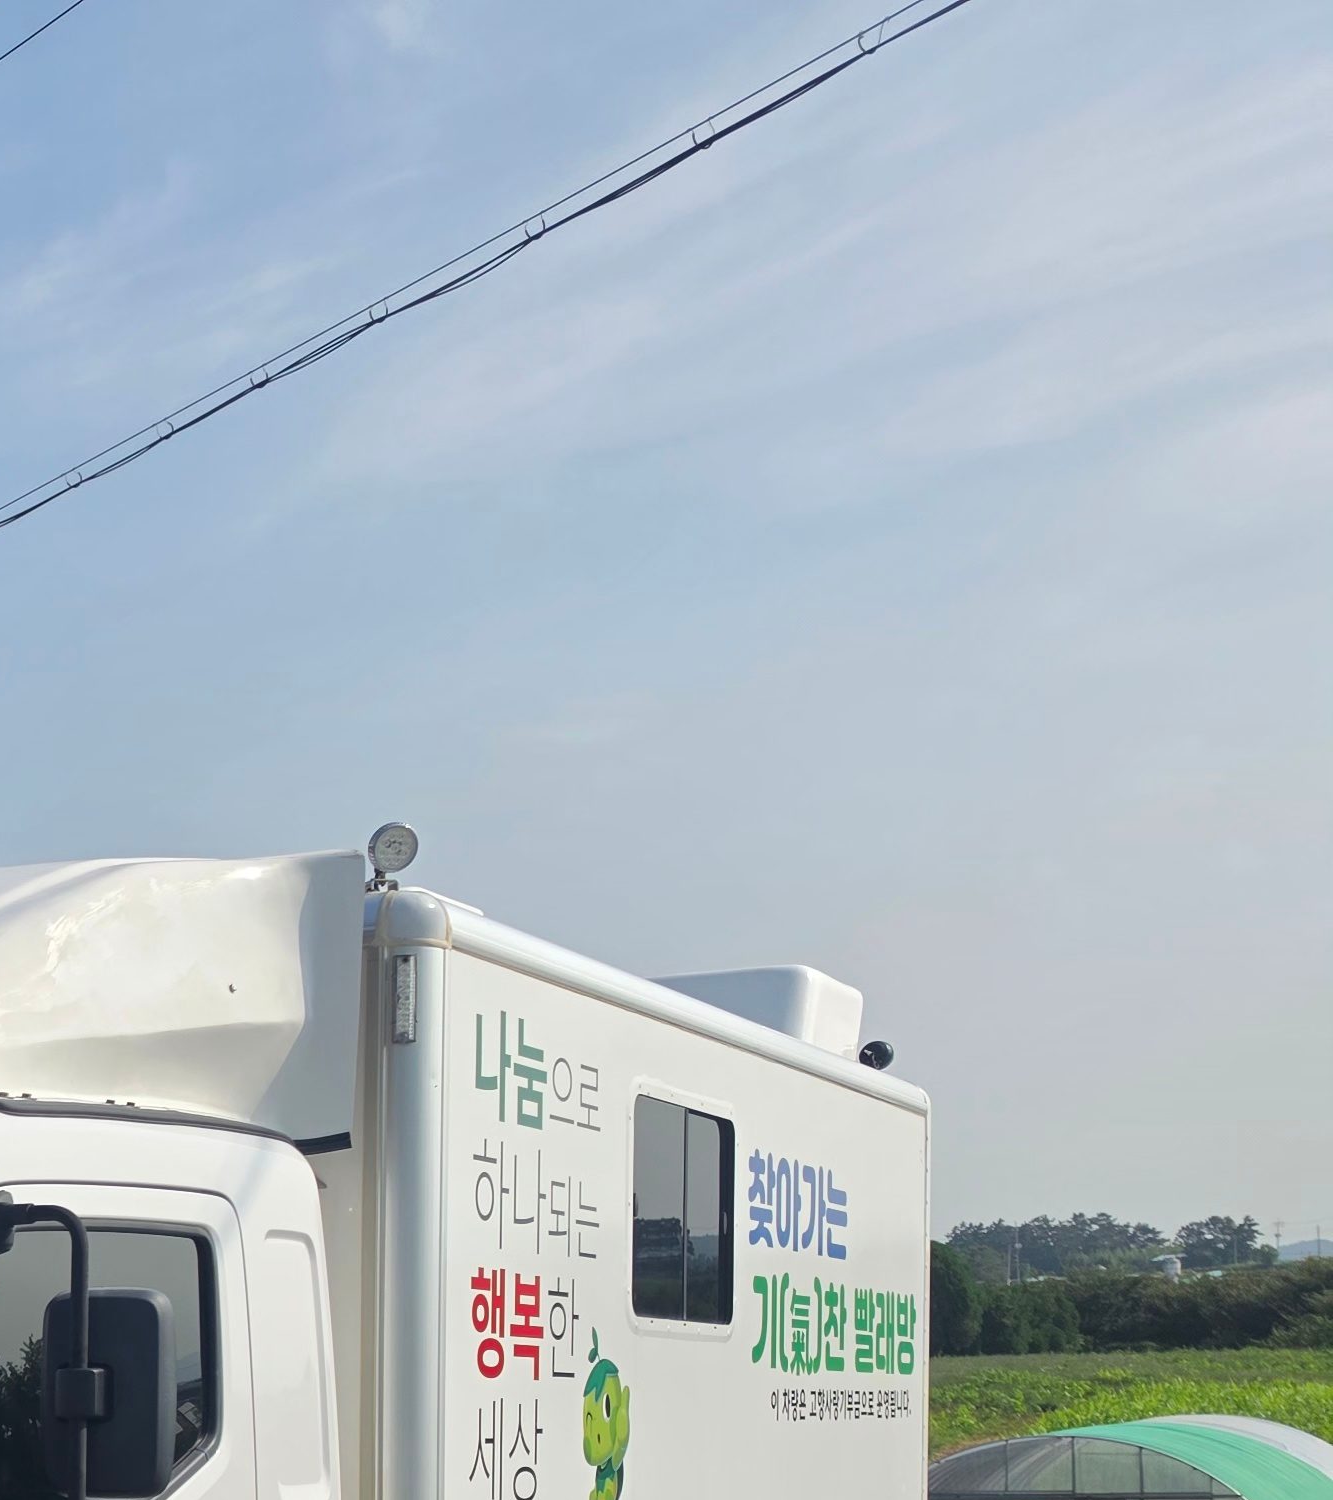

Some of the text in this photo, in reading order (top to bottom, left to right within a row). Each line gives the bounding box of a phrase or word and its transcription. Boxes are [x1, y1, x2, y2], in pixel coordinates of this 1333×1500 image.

[474, 1010, 602, 1132] 나눔으로
[472, 1138, 600, 1260] 하나되는
[748, 1148, 848, 1260] 찾아가는
[470, 1267, 580, 1382] 행복한
[854, 1289, 917, 1376] 빨래방
[770, 1388, 779, 1421] 이
[782, 1388, 807, 1422] 차량은
[809, 1389, 874, 1421] 고향사랑기부금으로
